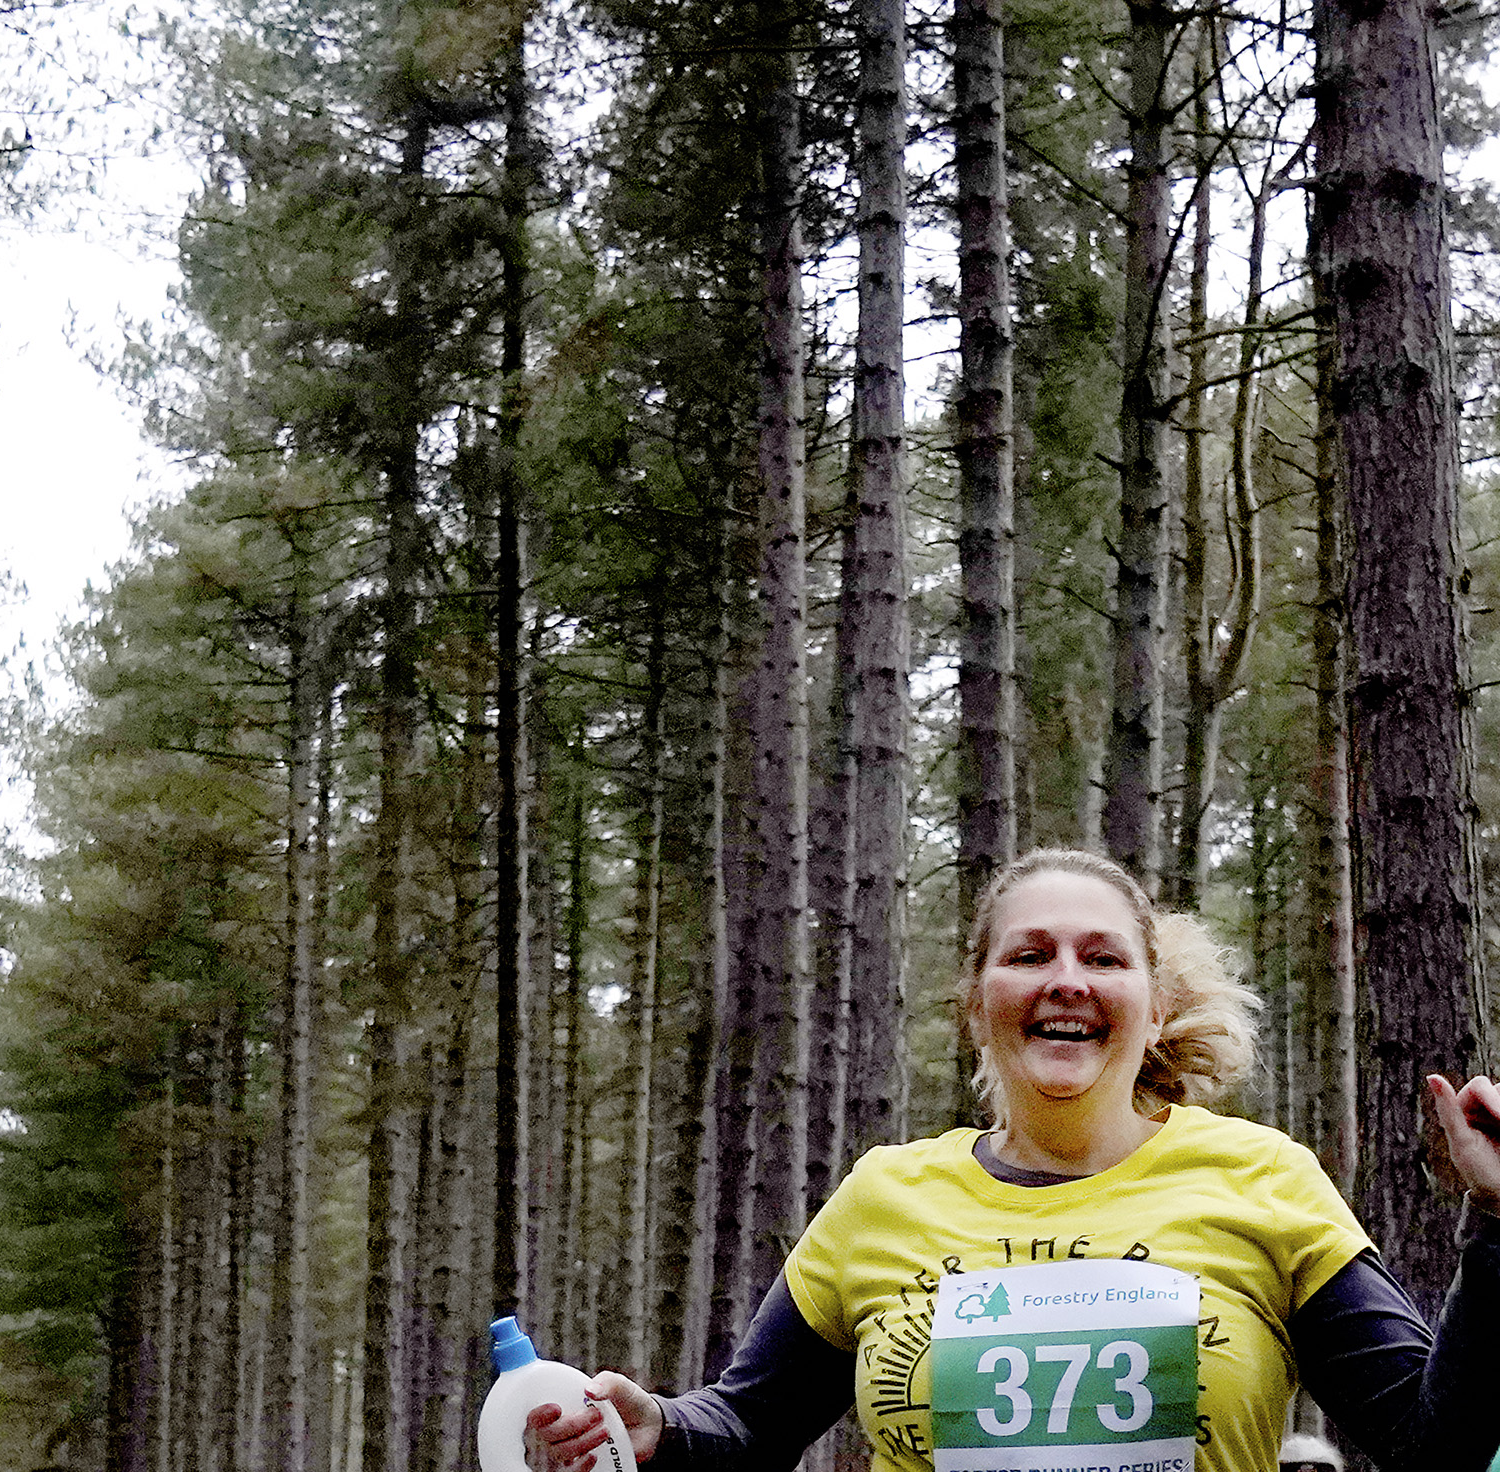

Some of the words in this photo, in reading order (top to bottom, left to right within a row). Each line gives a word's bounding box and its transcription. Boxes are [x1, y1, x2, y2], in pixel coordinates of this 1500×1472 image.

[996, 1233, 1096, 1264] THE
[1021, 1290, 1100, 1307] Forestry
[1105, 1286, 1180, 1304] England
[975, 1339, 1154, 1438] 373
